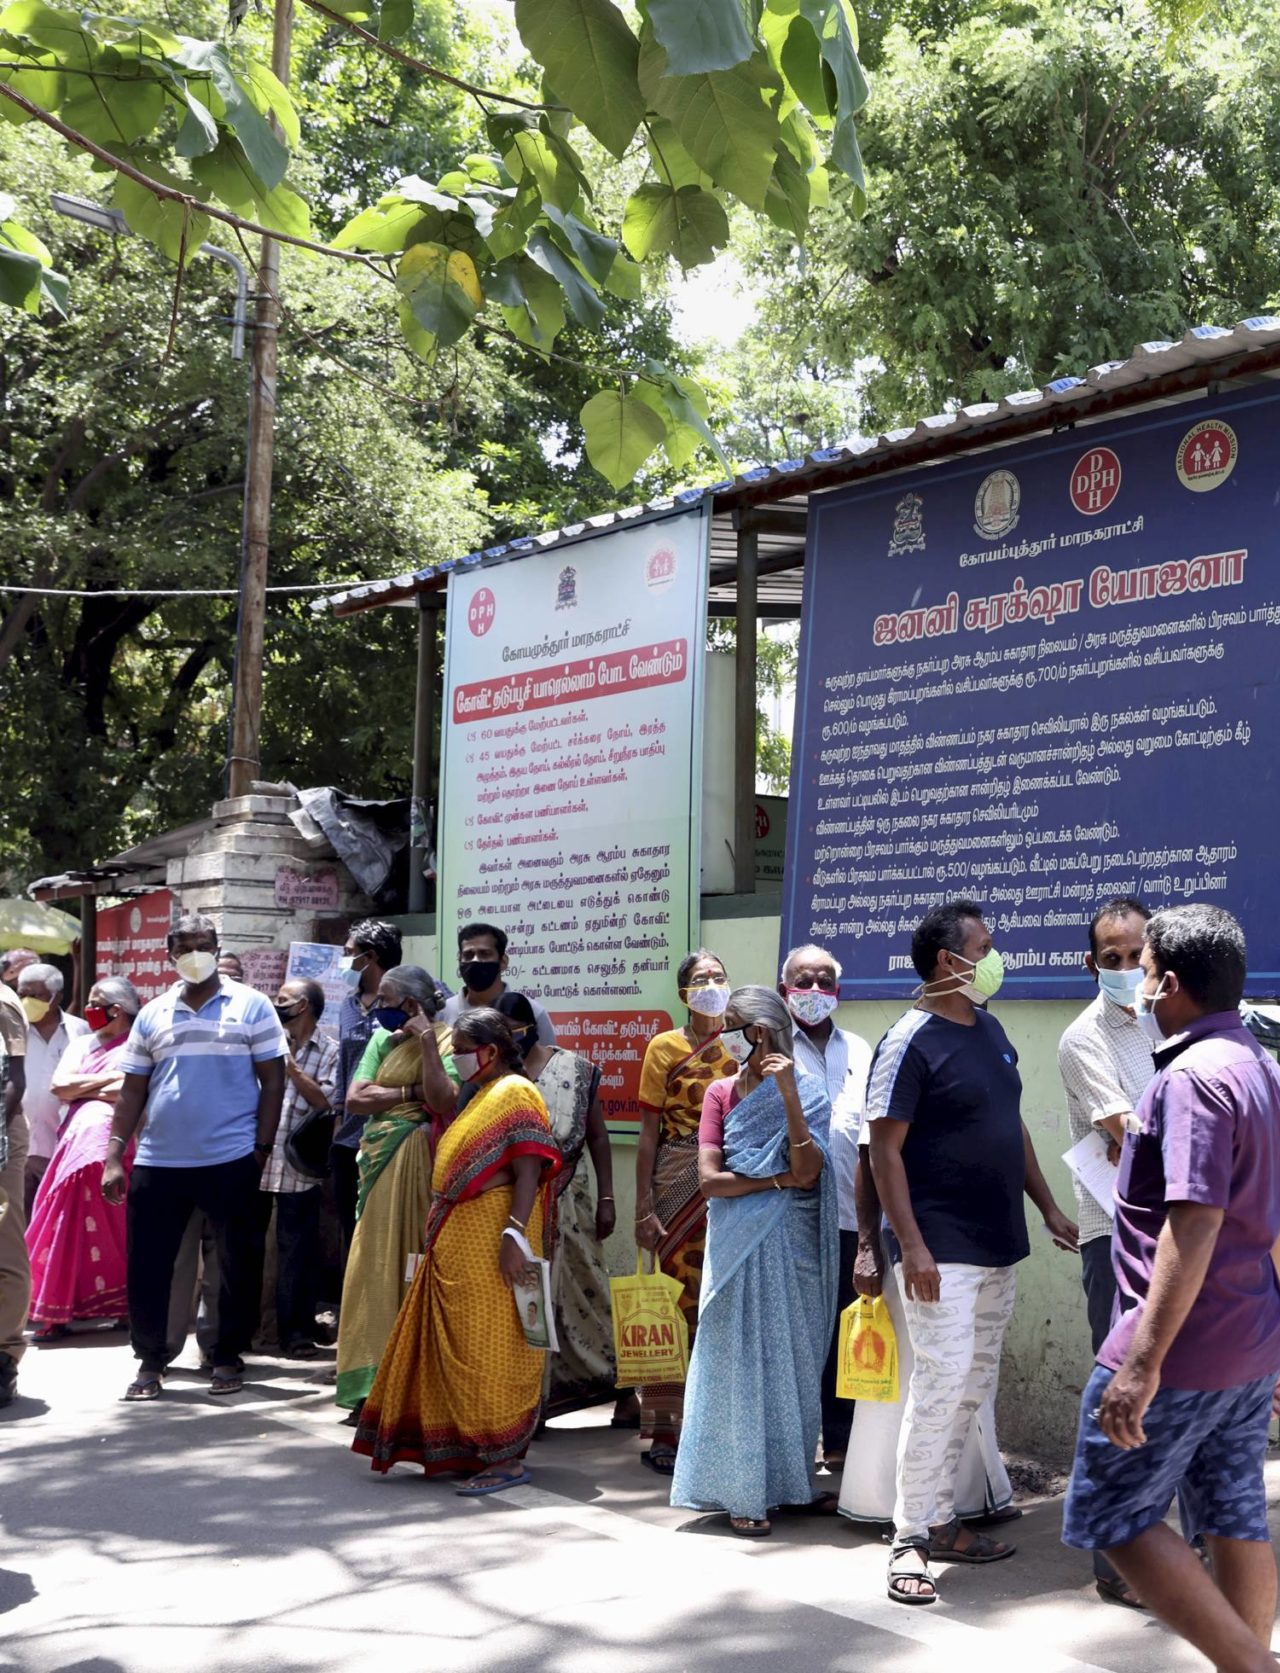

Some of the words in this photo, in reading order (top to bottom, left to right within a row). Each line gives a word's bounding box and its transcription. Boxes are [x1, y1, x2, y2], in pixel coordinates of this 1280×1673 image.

[959, 532, 1057, 568] கோயம்புத்தூர்
[1059, 514, 1144, 547] மாநகராட்சி
[872, 591, 959, 647] ஜனனி
[1088, 548, 1248, 609] யோஜனா
[501, 630, 569, 662] கோயமுத்தூர்
[571, 618, 631, 648] மாநகராட்சி
[456, 687, 492, 714] கோவிட்
[492, 675, 533, 712] தடுப்பூசி
[532, 659, 596, 700] யாரெல்லாம்
[597, 660, 627, 686] போட
[628, 643, 685, 679] வேண்டும்
[620, 1323, 675, 1347] KIRAN
[620, 1348, 674, 1358] JEWELLERY
